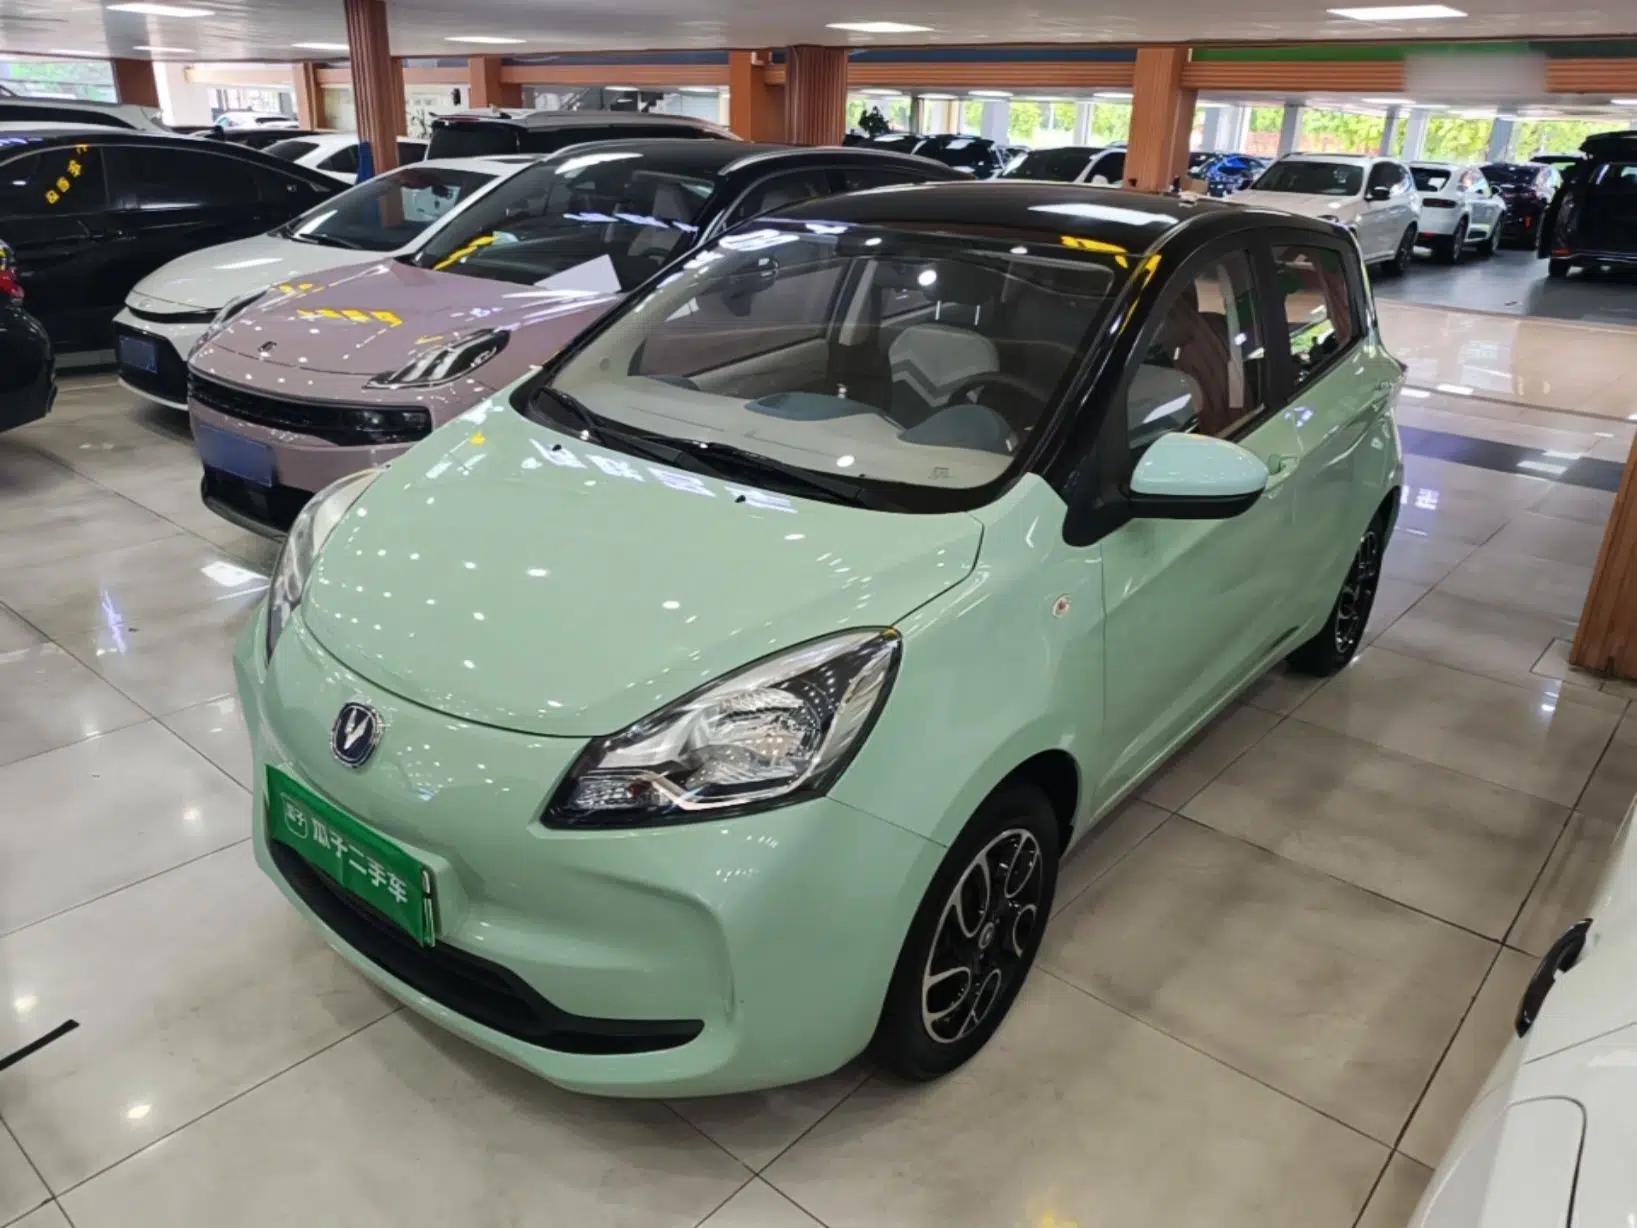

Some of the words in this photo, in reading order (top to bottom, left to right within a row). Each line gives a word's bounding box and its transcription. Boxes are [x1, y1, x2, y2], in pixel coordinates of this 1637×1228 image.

[311, 817, 408, 903] 瓜子二手车
